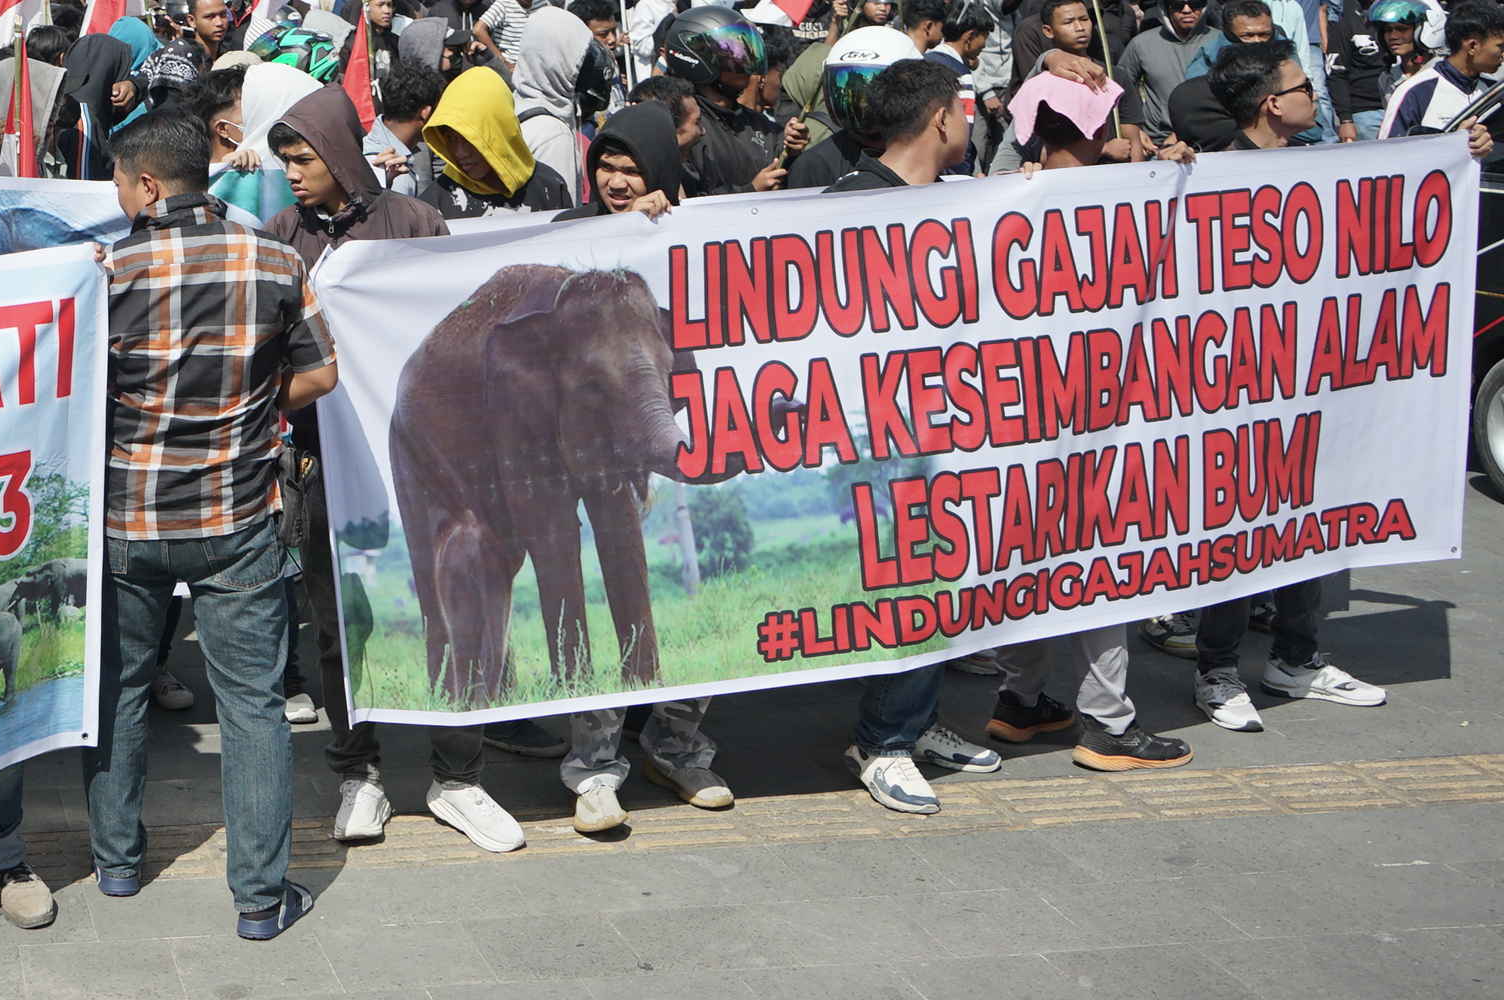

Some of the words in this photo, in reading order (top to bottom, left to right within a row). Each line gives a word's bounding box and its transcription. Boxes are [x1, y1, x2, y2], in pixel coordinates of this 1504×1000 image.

[668, 216, 979, 351] LINDUNGI
[991, 199, 1179, 320] GAJAH
[1185, 181, 1324, 294] TESO
[1337, 169, 1453, 280] NILO
[669, 358, 858, 480] JAGA
[860, 301, 1298, 461] KESEIMBANGAN
[1307, 282, 1451, 396] ALAM
[757, 498, 1417, 662] #LINDUNGIGAJAHSUMATRA
[851, 434, 1190, 591] LESTARIKAN
[1200, 410, 1323, 531] BUMI
